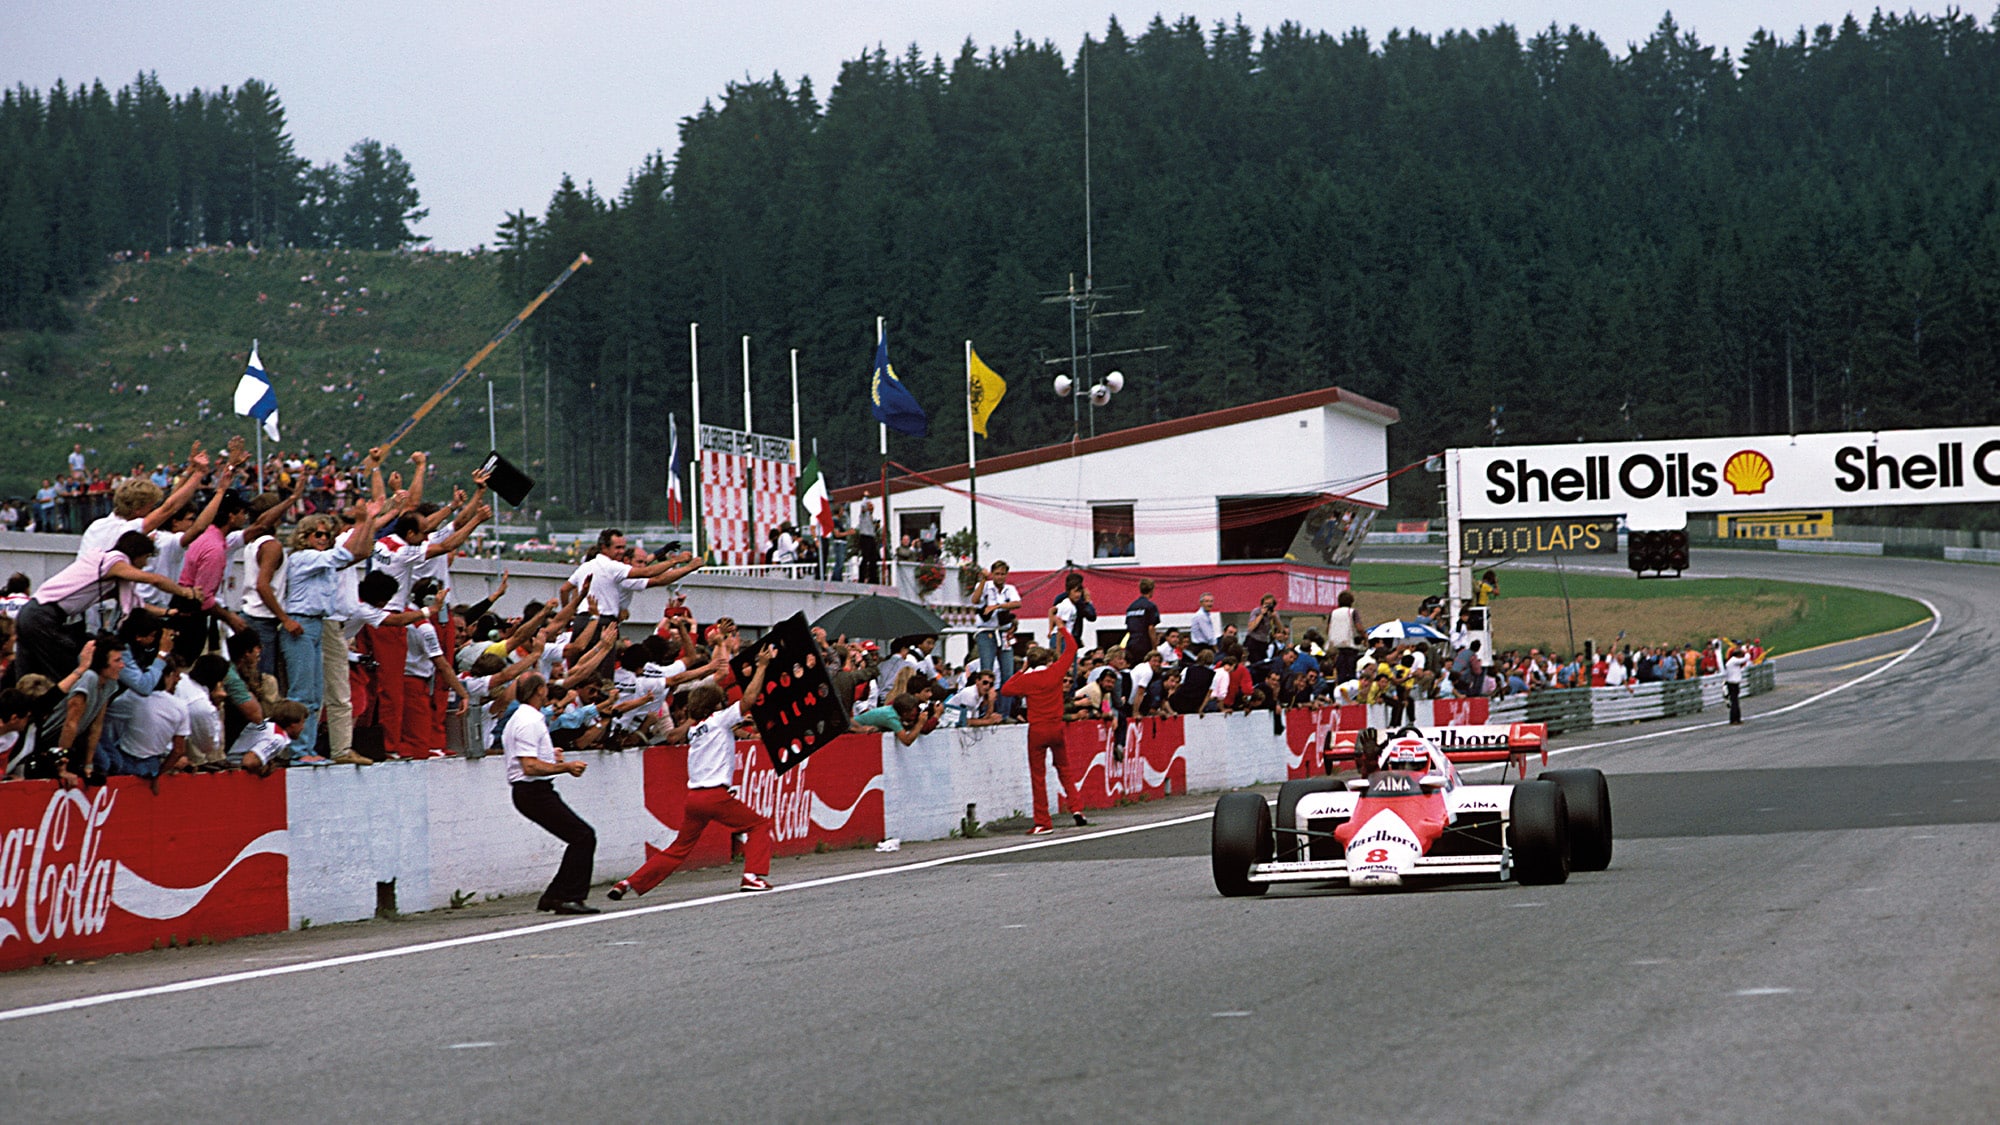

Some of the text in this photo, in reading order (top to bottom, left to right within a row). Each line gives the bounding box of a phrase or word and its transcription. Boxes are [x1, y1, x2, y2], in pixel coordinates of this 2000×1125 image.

[1486, 453, 1718, 504] Shell Oils
[1835, 442, 1963, 492] Shell
[1536, 523, 1601, 551] LAPS
[1386, 729, 1509, 747] rlboro
[1347, 830, 1418, 853] Marlboro
[0, 786, 118, 944] a-Cola
[1365, 849, 1388, 863] 8
